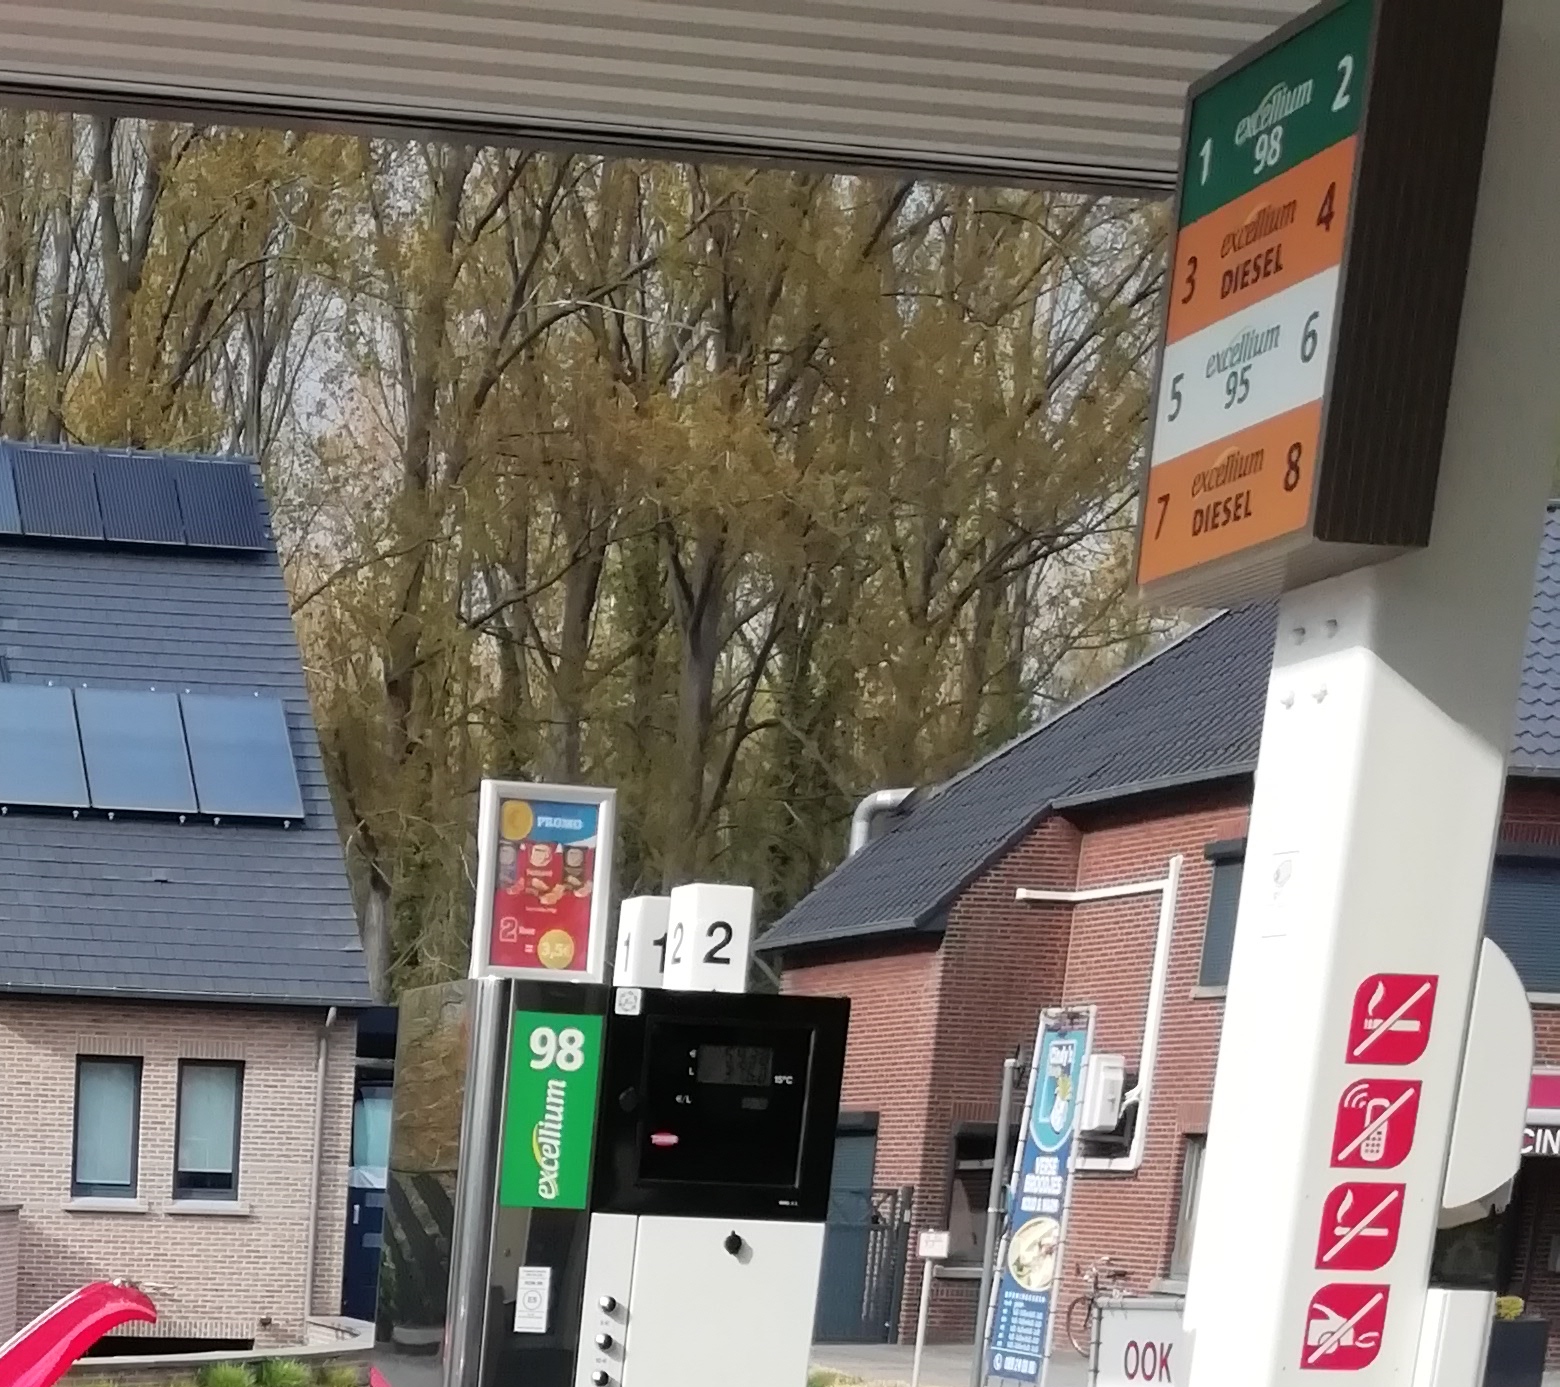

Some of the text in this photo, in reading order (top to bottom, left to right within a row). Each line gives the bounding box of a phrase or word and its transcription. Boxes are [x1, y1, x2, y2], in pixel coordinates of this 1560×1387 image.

[1332, 54, 1354, 112] 2
[1235, 78, 1314, 146] excellium
[1200, 138, 1213, 186] 1
[1253, 125, 1284, 175] 98
[1220, 200, 1297, 259] excellium
[1316, 181, 1336, 232] 4
[1181, 256, 1198, 304] 3
[1220, 243, 1284, 300] DIESEL
[1205, 325, 1281, 379] excellium
[1300, 311, 1320, 364] 6
[1168, 372, 1185, 422] 5
[1224, 363, 1253, 410] 95
[1191, 449, 1265, 499] excellium
[1283, 441, 1303, 492] 8
[1154, 493, 1171, 541] 7
[1192, 490, 1253, 537] DIESEL
[499, 916, 518, 944] 2
[624, 932, 631, 973] 1
[653, 932, 668, 974] 1
[671, 922, 684, 965] 2
[703, 920, 733, 965] 2
[529, 1026, 585, 1072] 98
[537, 1078, 568, 1200] excellium
[1124, 1340, 1174, 1383] OOK
